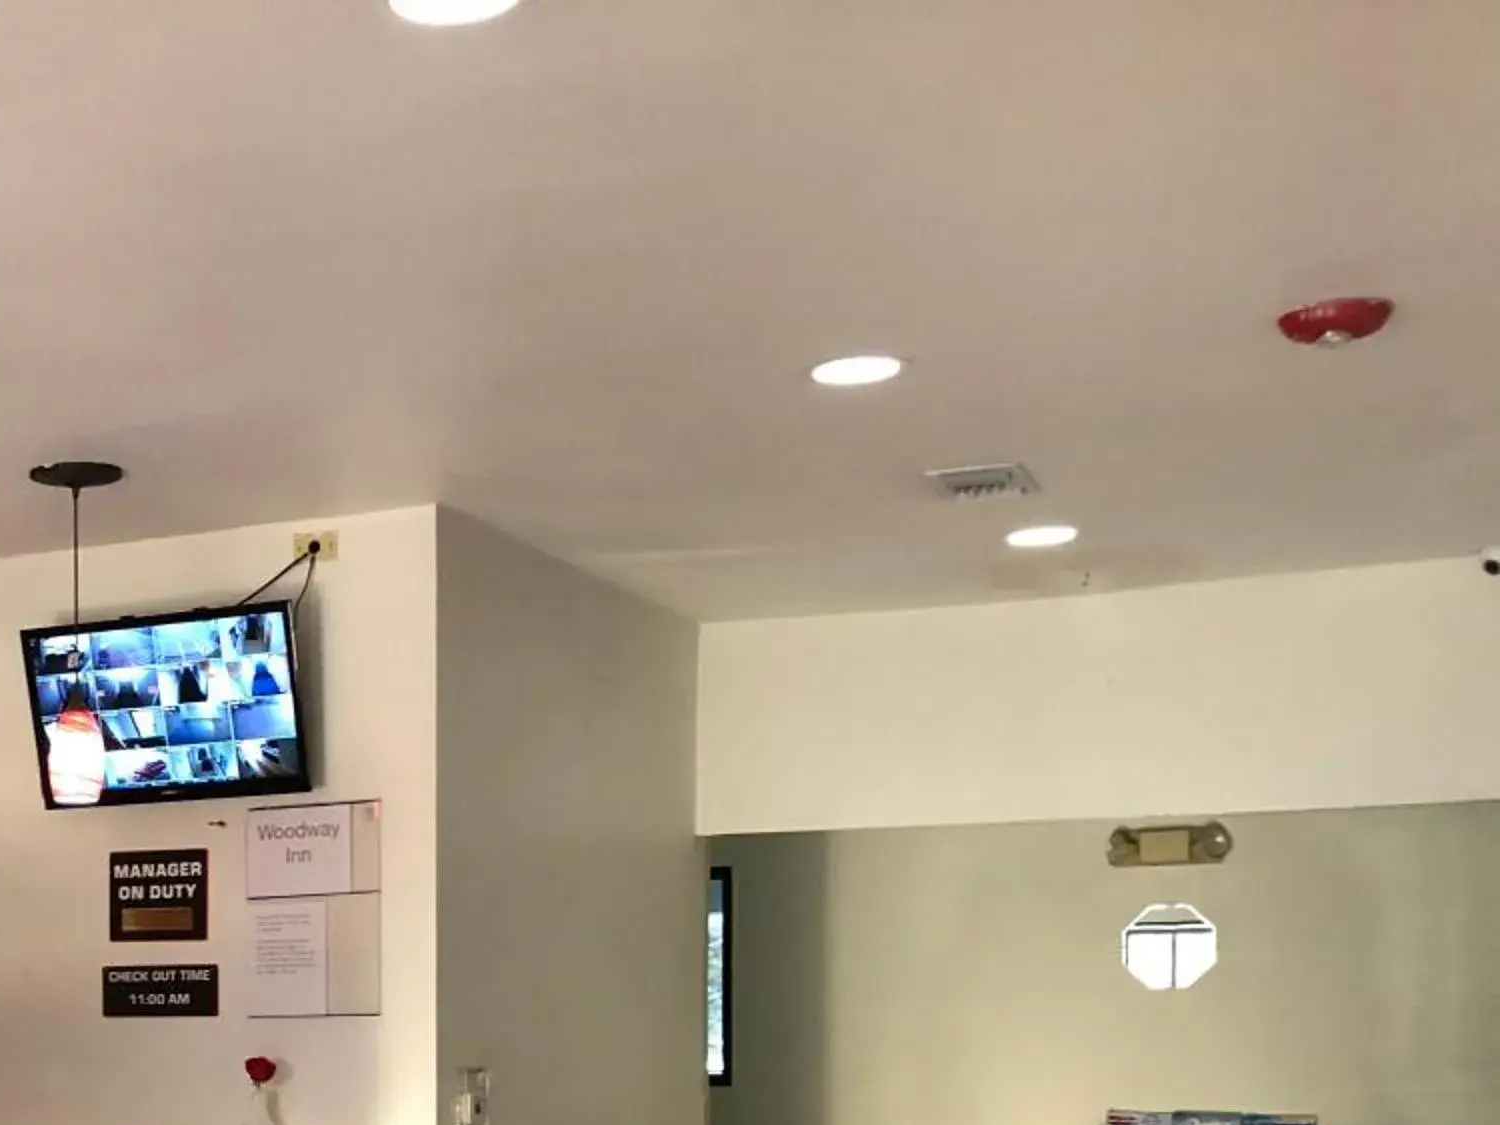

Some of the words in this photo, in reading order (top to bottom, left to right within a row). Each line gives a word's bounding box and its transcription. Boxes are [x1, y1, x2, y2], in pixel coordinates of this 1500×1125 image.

[257, 821, 340, 840] Woodway
[285, 847, 312, 864] Inn
[113, 861, 203, 879] MANAGER
[118, 885, 145, 900] ON
[149, 883, 197, 899] DUTY
[108, 971, 149, 983] CHECK
[151, 970, 177, 982] OUT
[180, 969, 211, 981] TIME
[168, 993, 191, 1005] AM
